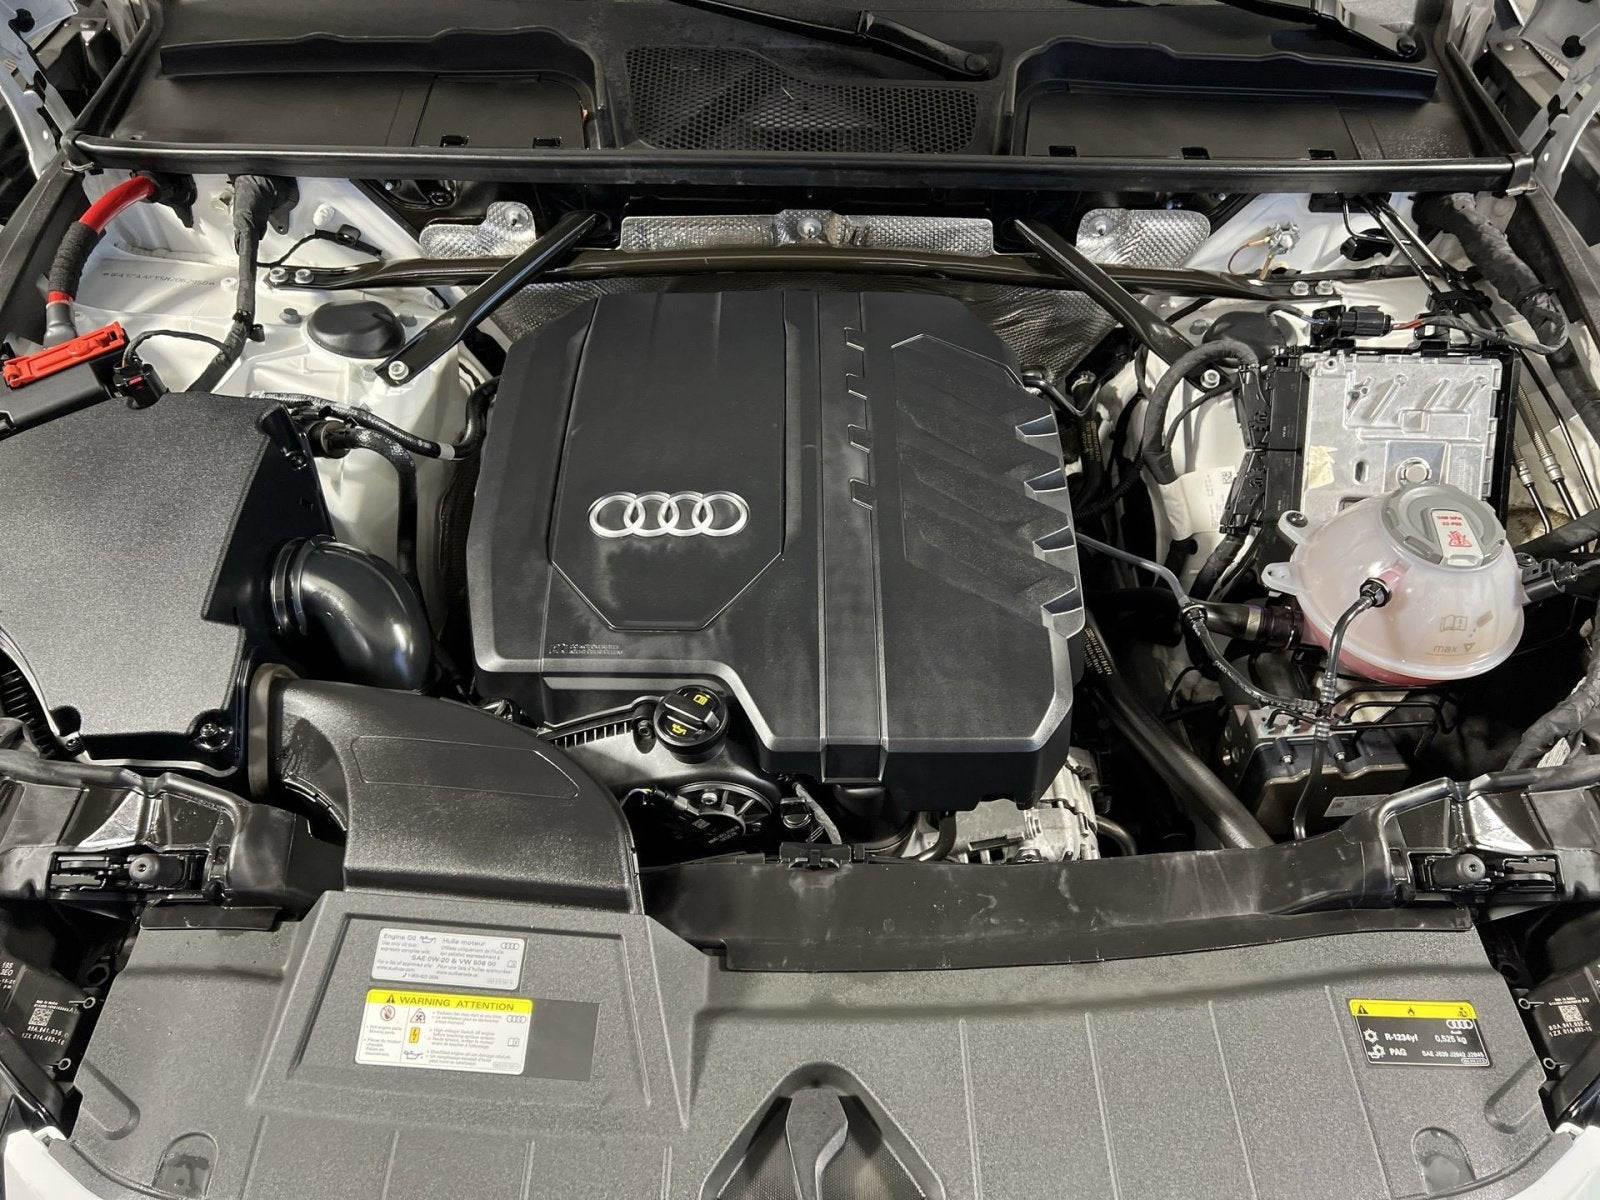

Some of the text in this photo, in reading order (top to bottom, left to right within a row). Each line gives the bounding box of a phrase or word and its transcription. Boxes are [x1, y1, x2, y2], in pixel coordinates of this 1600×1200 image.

[400, 996, 515, 1011] WARNING ATTENTION
[1384, 1033, 1468, 1044] R-1234yf 0,525 kg
[1389, 1048, 1408, 1056] PAG
